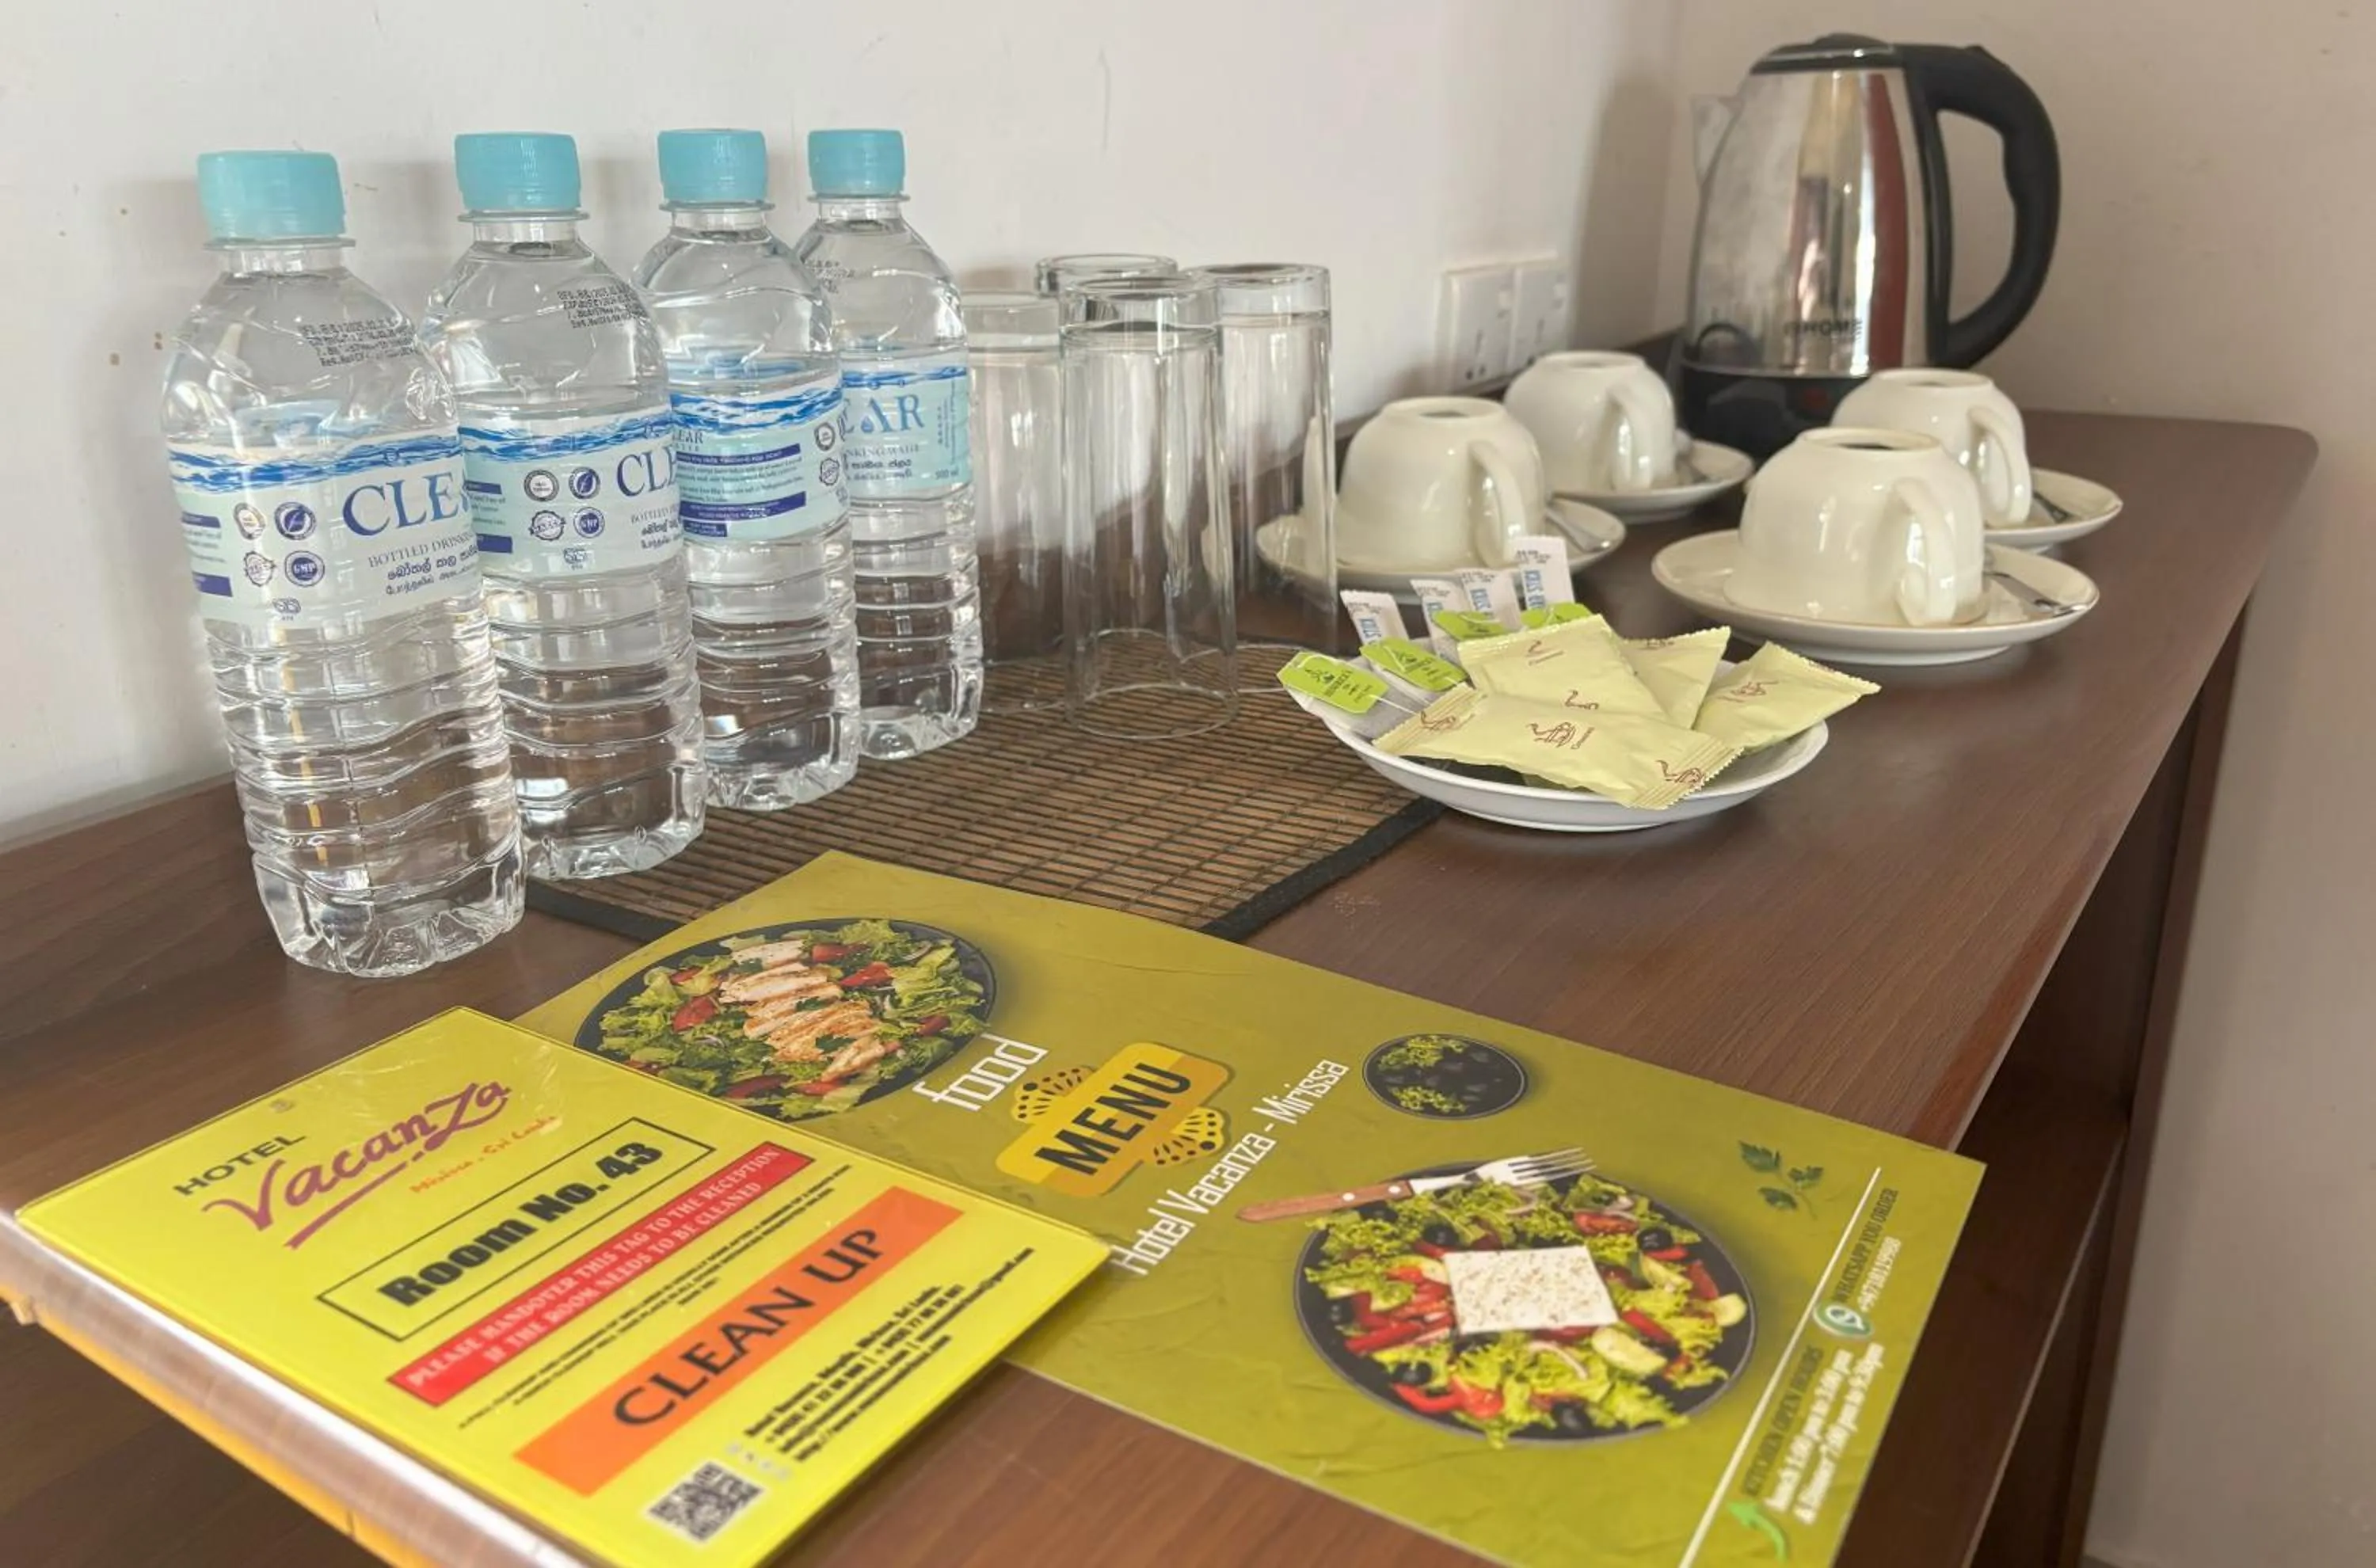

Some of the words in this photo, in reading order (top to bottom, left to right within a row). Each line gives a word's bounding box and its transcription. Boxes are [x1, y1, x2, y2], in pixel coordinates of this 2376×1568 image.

[367, 544, 429, 569] BOTTLED
[913, 1033, 1048, 1112] food
[1034, 1063, 1191, 1174] MENU
[173, 1132, 306, 1197] HOTEL
[375, 1214, 539, 1308] Room
[516, 1172, 611, 1223] No.
[595, 1142, 664, 1183] 43
[1110, 1207, 1197, 1276] Hotel
[1156, 1131, 1277, 1215] Vacanza
[1251, 1059, 1350, 1125] Mirissa
[404, 1336, 485, 1387] PLEASE
[476, 1275, 581, 1341] HANDOVER
[571, 1250, 621, 1279] THIS
[611, 1230, 653, 1254] TAG
[642, 1216, 676, 1234] TO
[664, 1196, 707, 1220] THE
[695, 1147, 783, 1200] RECEPTION
[502, 1319, 550, 1349] THE
[540, 1285, 604, 1323] ROOM
[592, 1251, 656, 1289] NEEDS
[645, 1236, 680, 1255] TO
[668, 1222, 701, 1240] BE
[690, 1180, 766, 1226] CLEANED
[612, 1287, 816, 1426] CLEAN
[804, 1228, 884, 1285] UP
